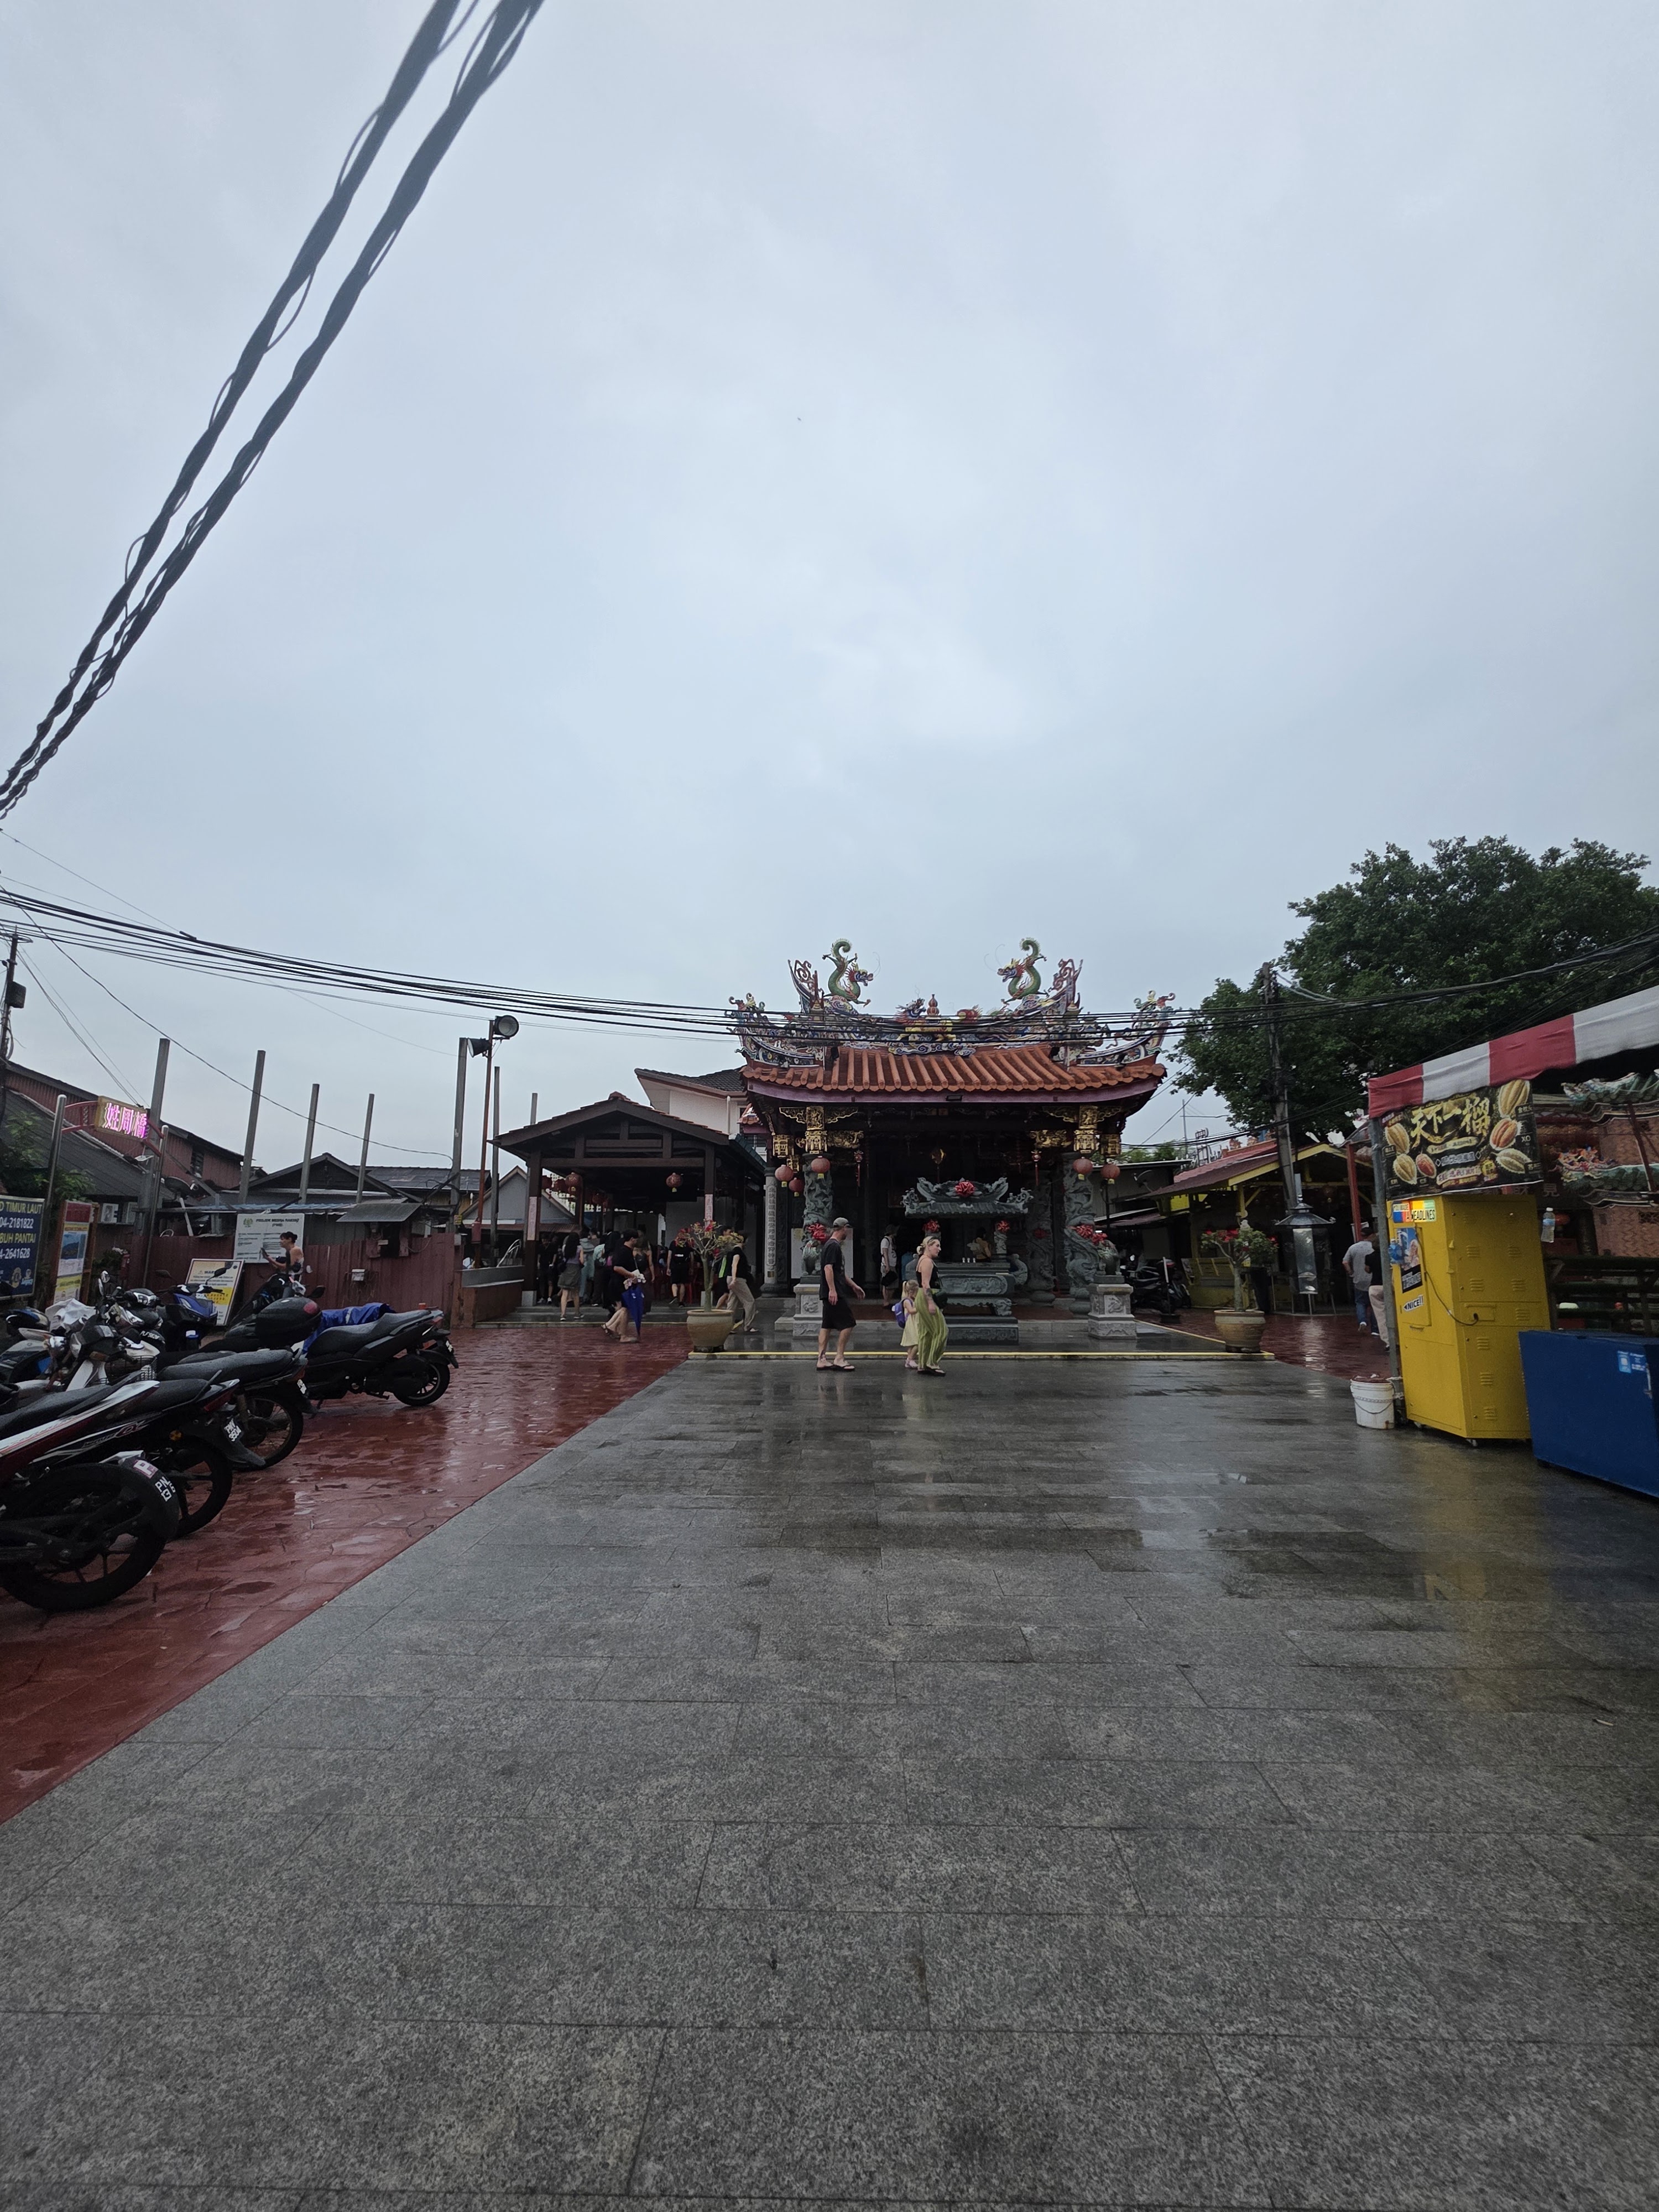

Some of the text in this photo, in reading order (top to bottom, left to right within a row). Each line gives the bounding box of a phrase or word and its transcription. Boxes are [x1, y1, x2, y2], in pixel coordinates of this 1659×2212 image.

[6, 1202, 26, 1213] TIMUR
[27, 1203, 43, 1214] LAUT
[15, 1233, 36, 1243] PANTAI
